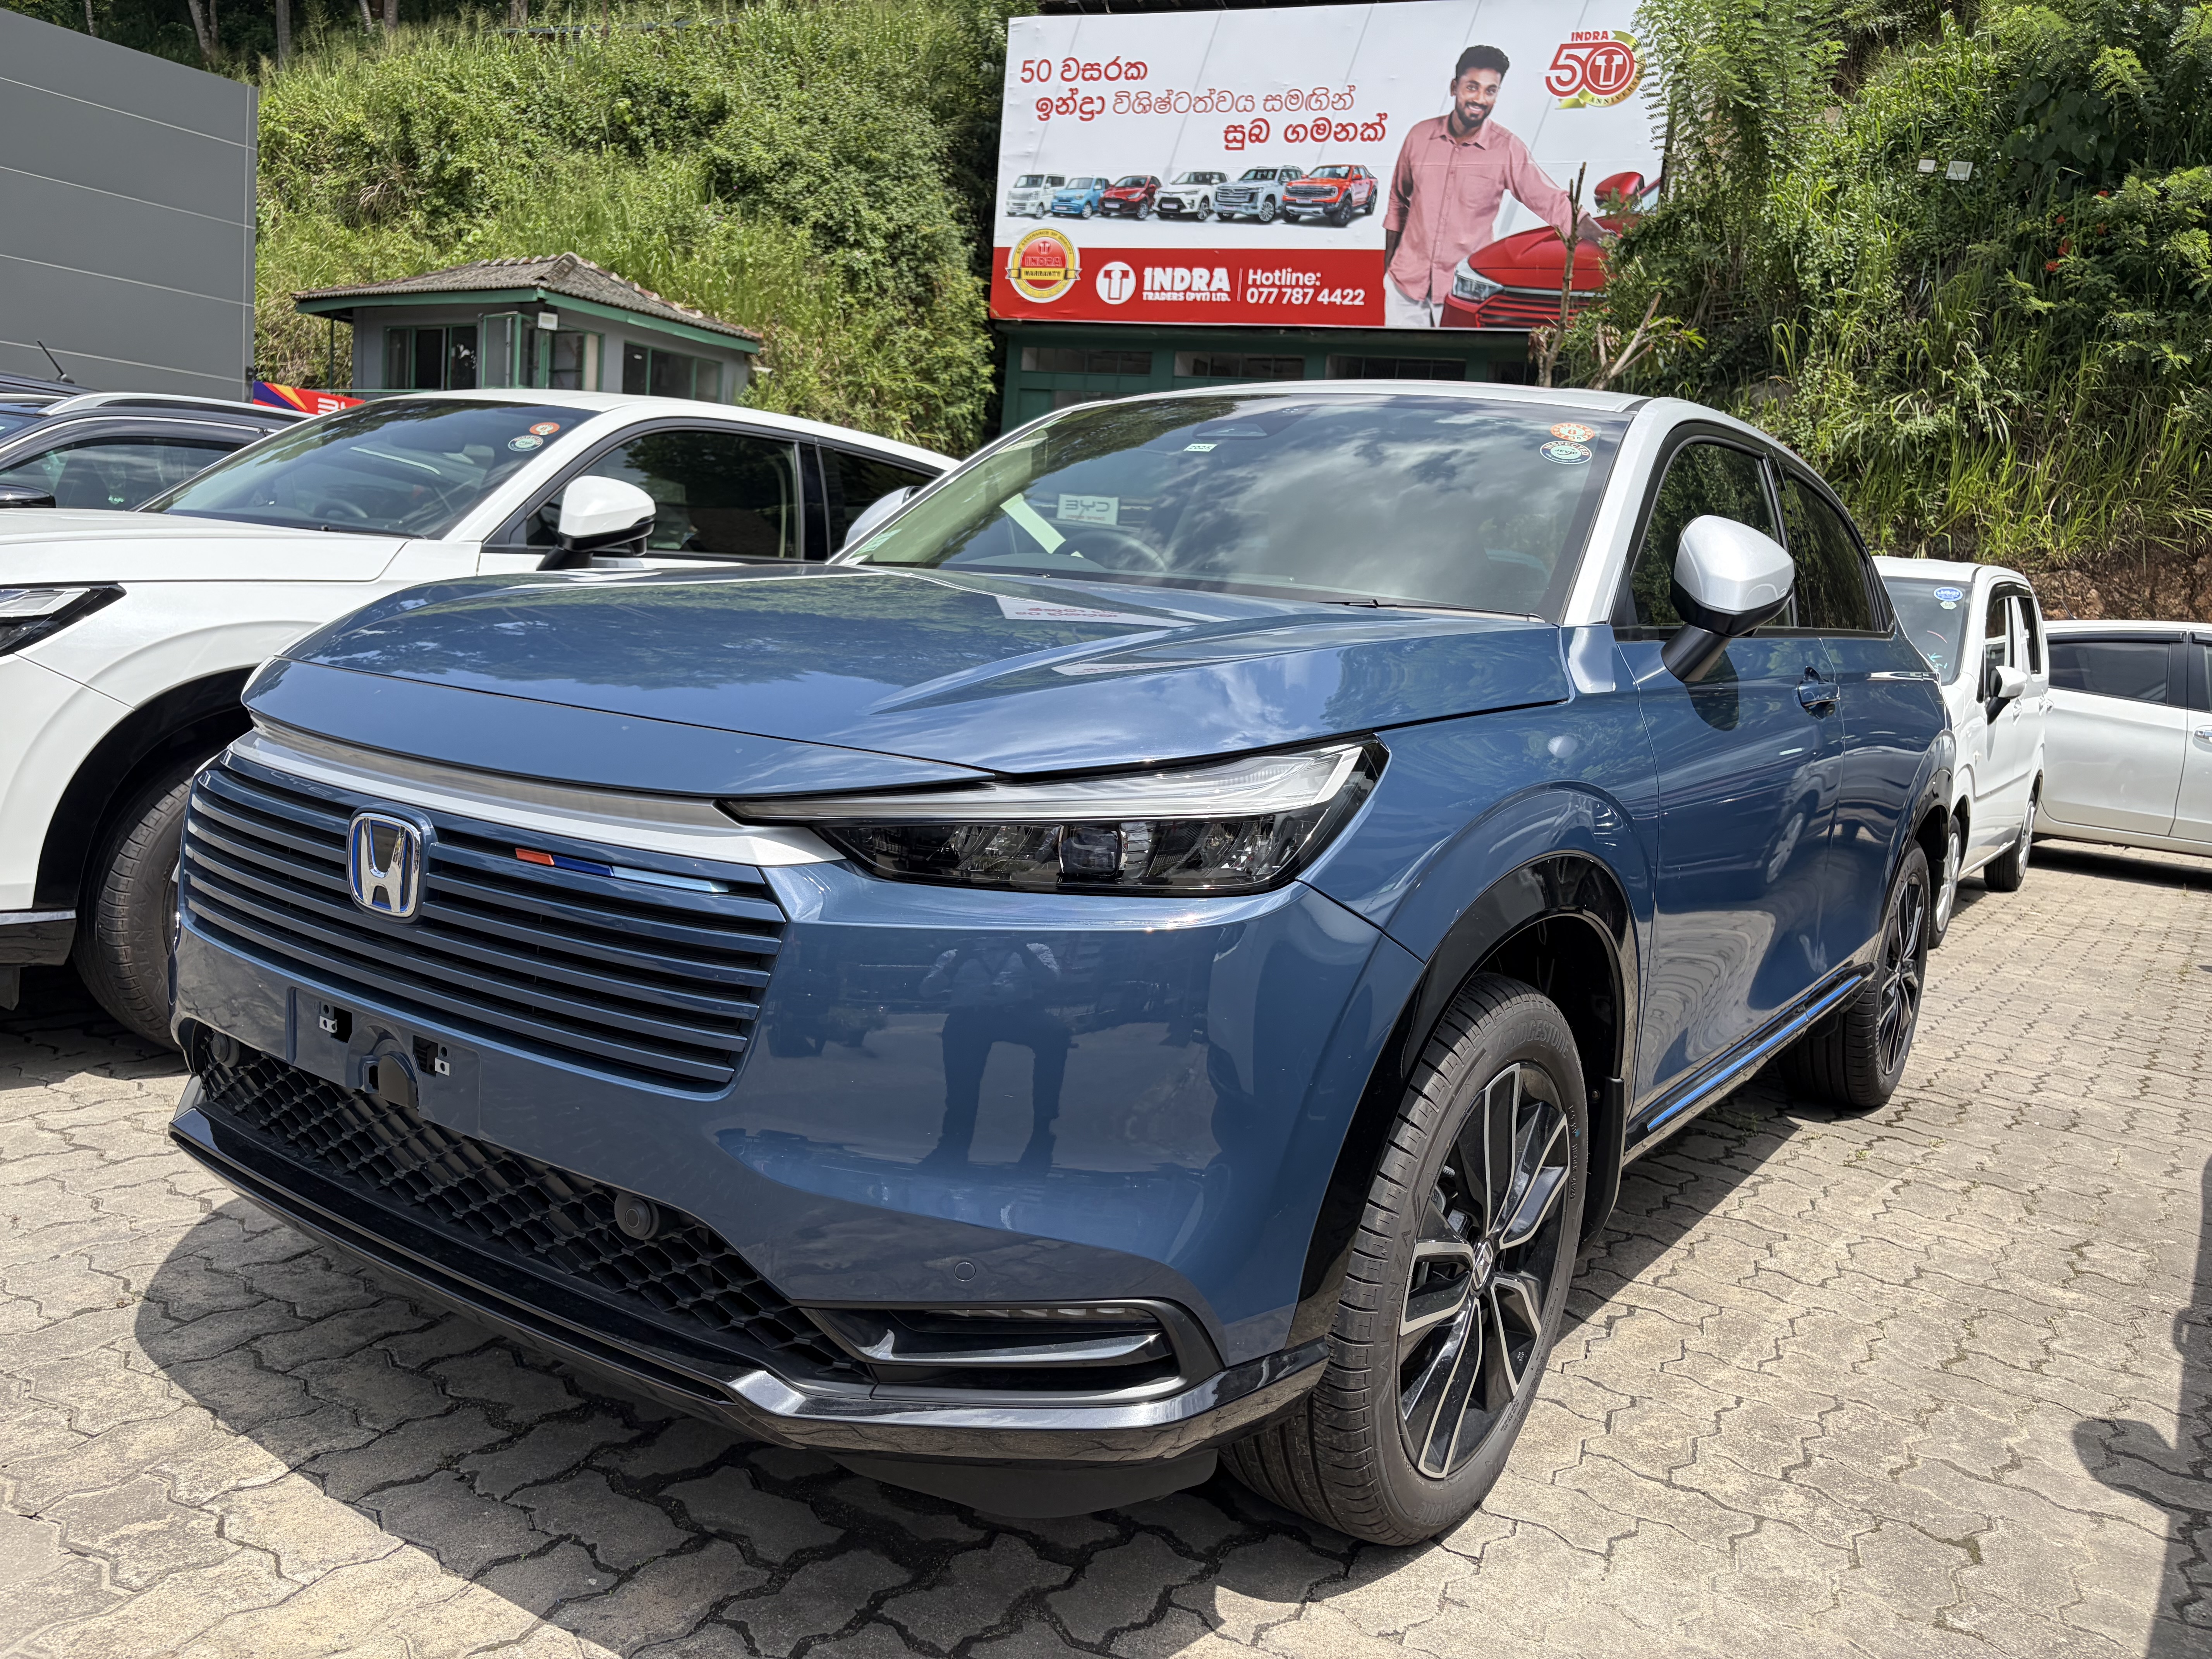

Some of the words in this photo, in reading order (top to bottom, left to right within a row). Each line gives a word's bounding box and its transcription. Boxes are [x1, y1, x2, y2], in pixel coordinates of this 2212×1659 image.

[1571, 30, 1609, 41] INDRA
[1020, 58, 1052, 83] 50
[1060, 56, 1148, 82] වසරක
[1223, 117, 1270, 151] සුබ
[1283, 112, 1388, 143] ගමනක්
[1025, 256, 1063, 267] INDRA
[1143, 268, 1231, 291] INDRA
[1248, 268, 1321, 286] Hotline:
[1142, 292, 1185, 301] TRADERS
[1247, 288, 1278, 304] 077
[1282, 288, 1314, 305] 787
[1317, 289, 1365, 306] 4422
[1544, 441, 1589, 456] INSPECTED
